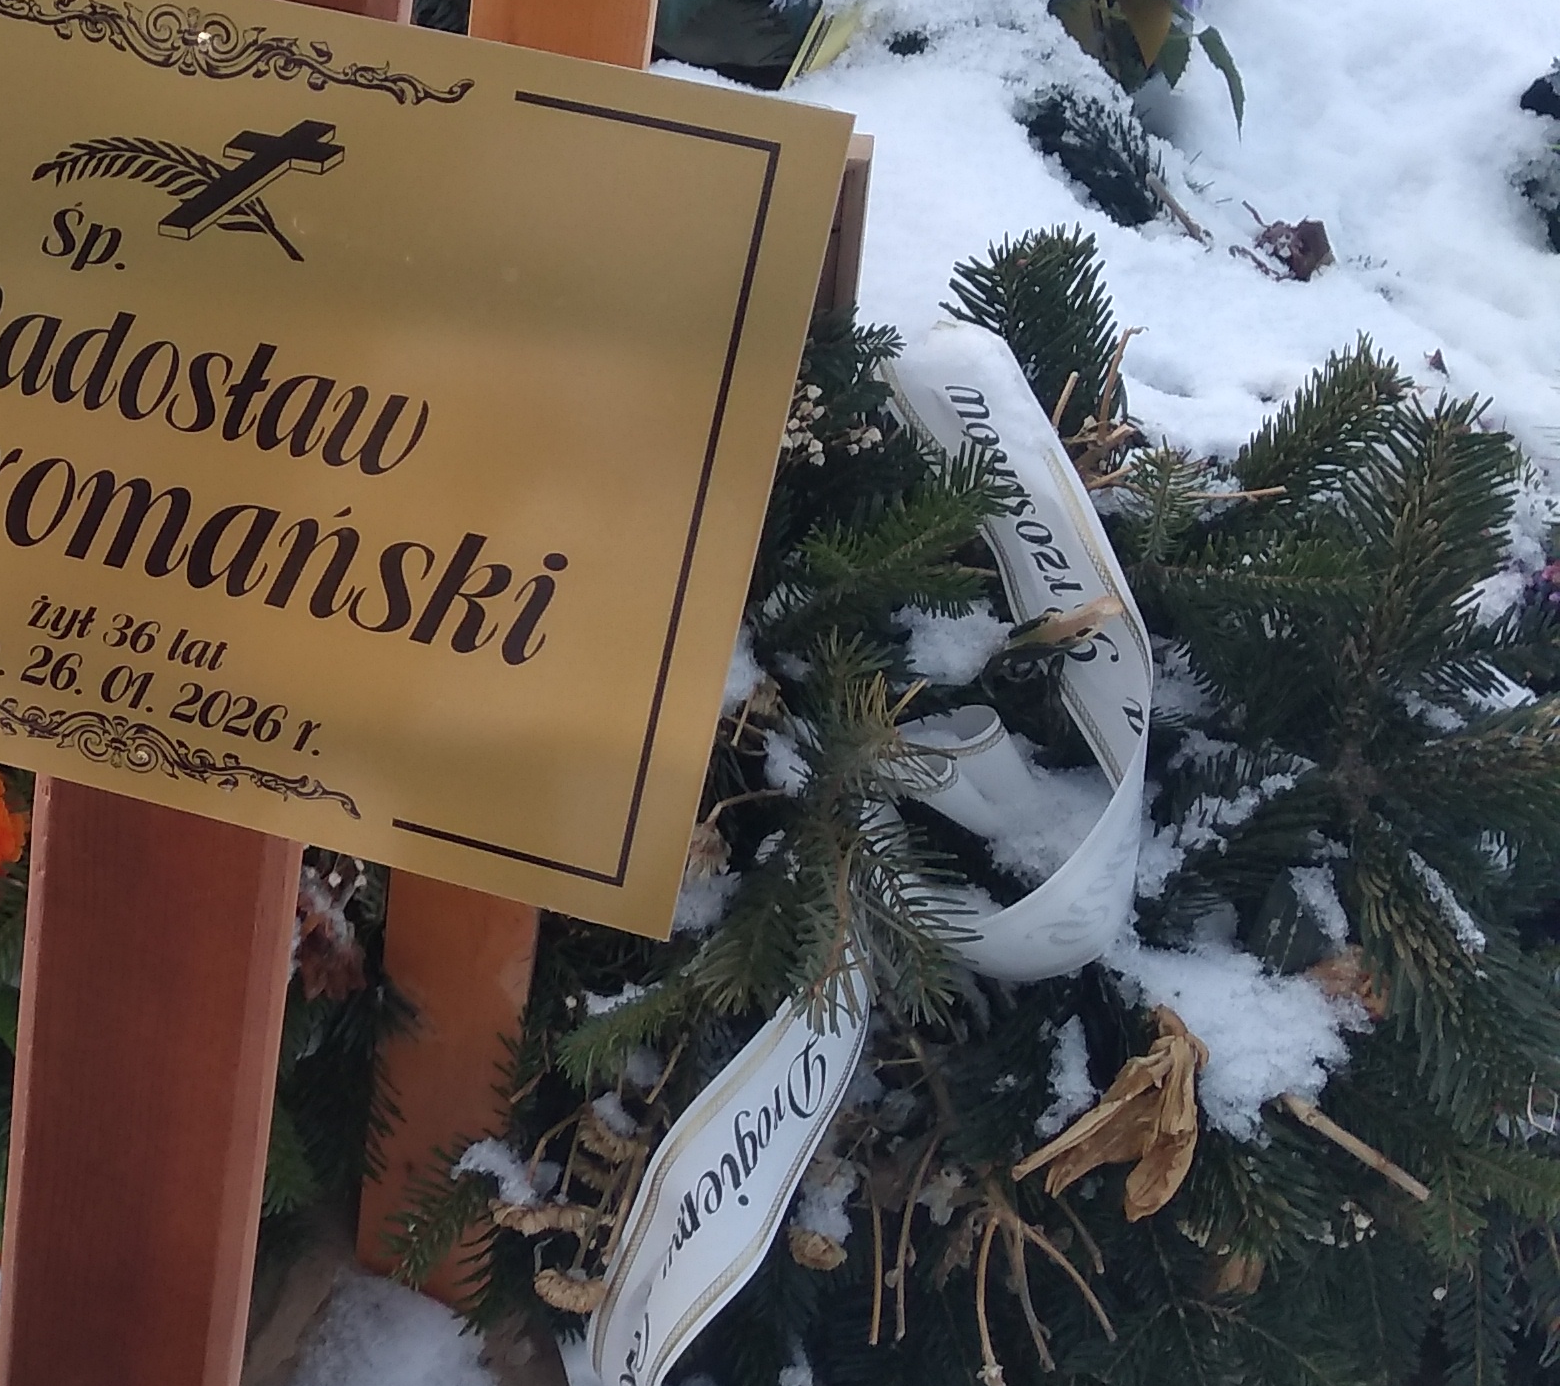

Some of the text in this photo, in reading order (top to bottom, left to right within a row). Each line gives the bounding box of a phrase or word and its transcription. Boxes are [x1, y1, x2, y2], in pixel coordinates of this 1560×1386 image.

[41, 201, 126, 272] Śp.
[28, 595, 229, 672] żył 36 lat
[20, 644, 83, 696] 26.
[100, 665, 155, 713] 01.
[169, 682, 288, 744] 2026
[292, 718, 321, 757] r.
